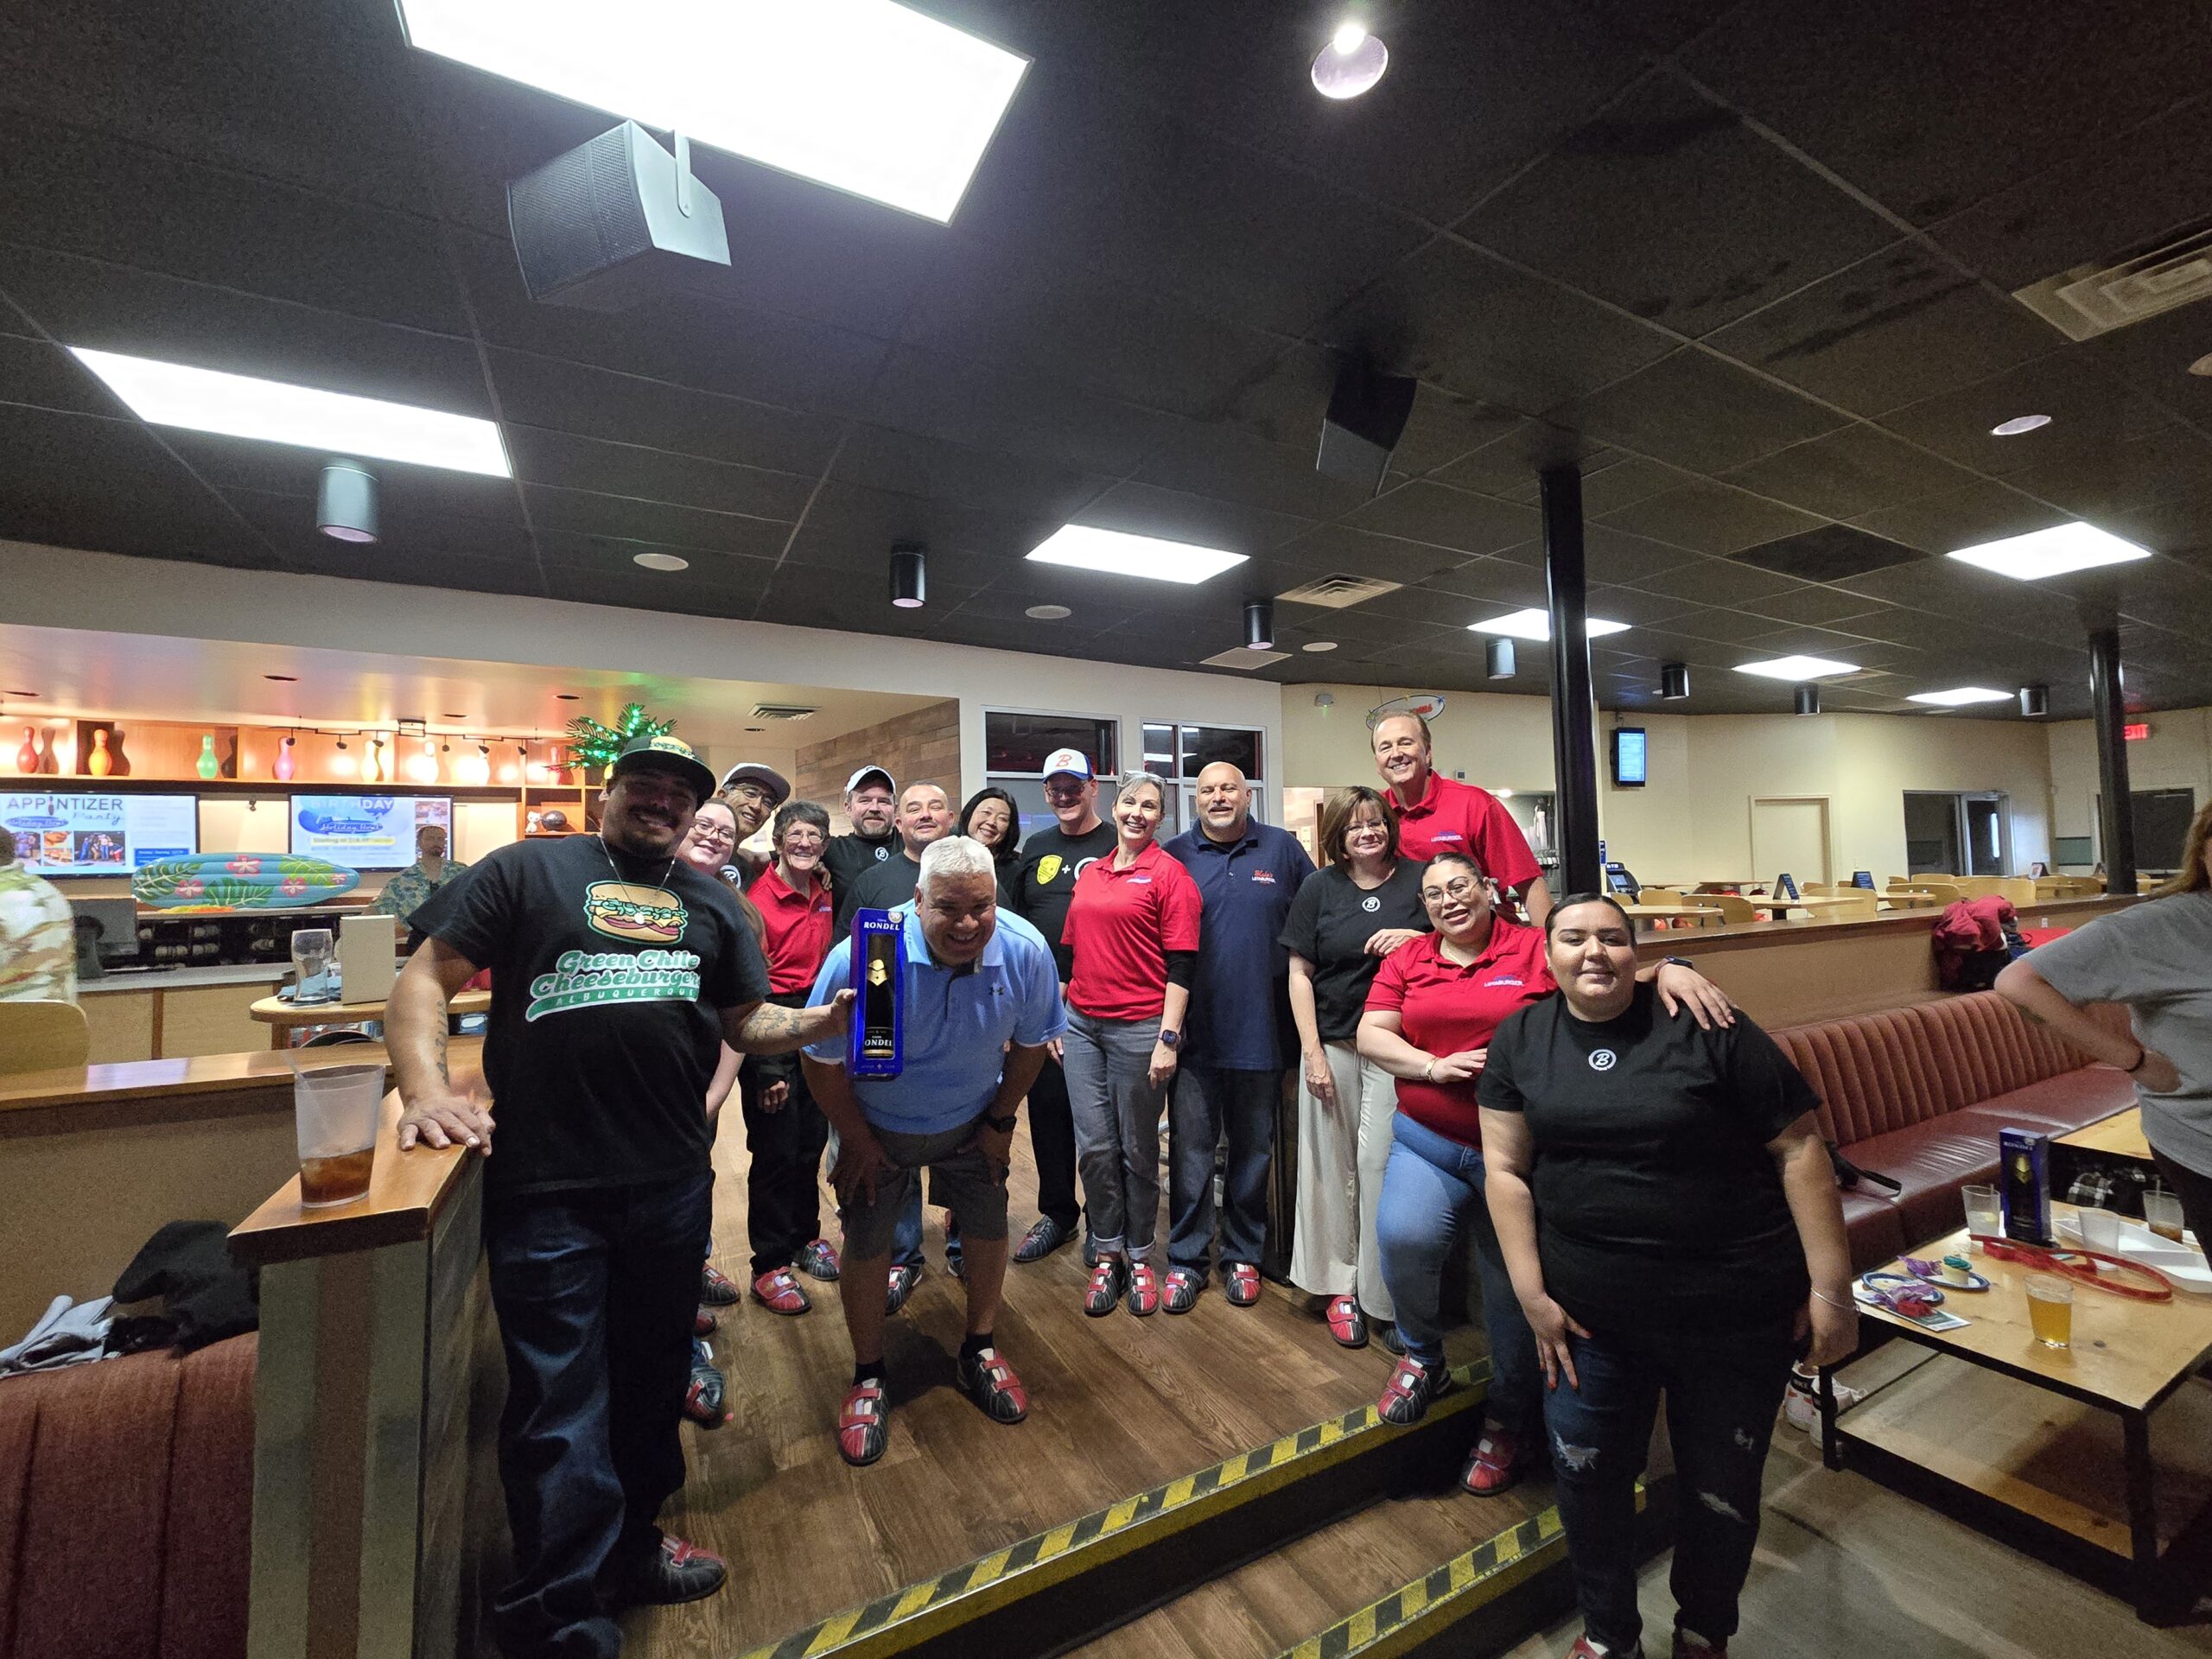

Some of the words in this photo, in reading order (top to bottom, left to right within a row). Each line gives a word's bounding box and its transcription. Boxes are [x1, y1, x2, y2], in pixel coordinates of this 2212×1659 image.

[1054, 753, 1072, 767] B
[320, 821, 358, 834] Holiday
[863, 921, 900, 931] RONDEL
[556, 950, 638, 975] Green
[637, 949, 701, 969] Chile
[530, 959, 702, 999] Cheeseburger
[556, 988, 694, 1007] ALBUQUERQUE
[1595, 1052, 1611, 1066] B
